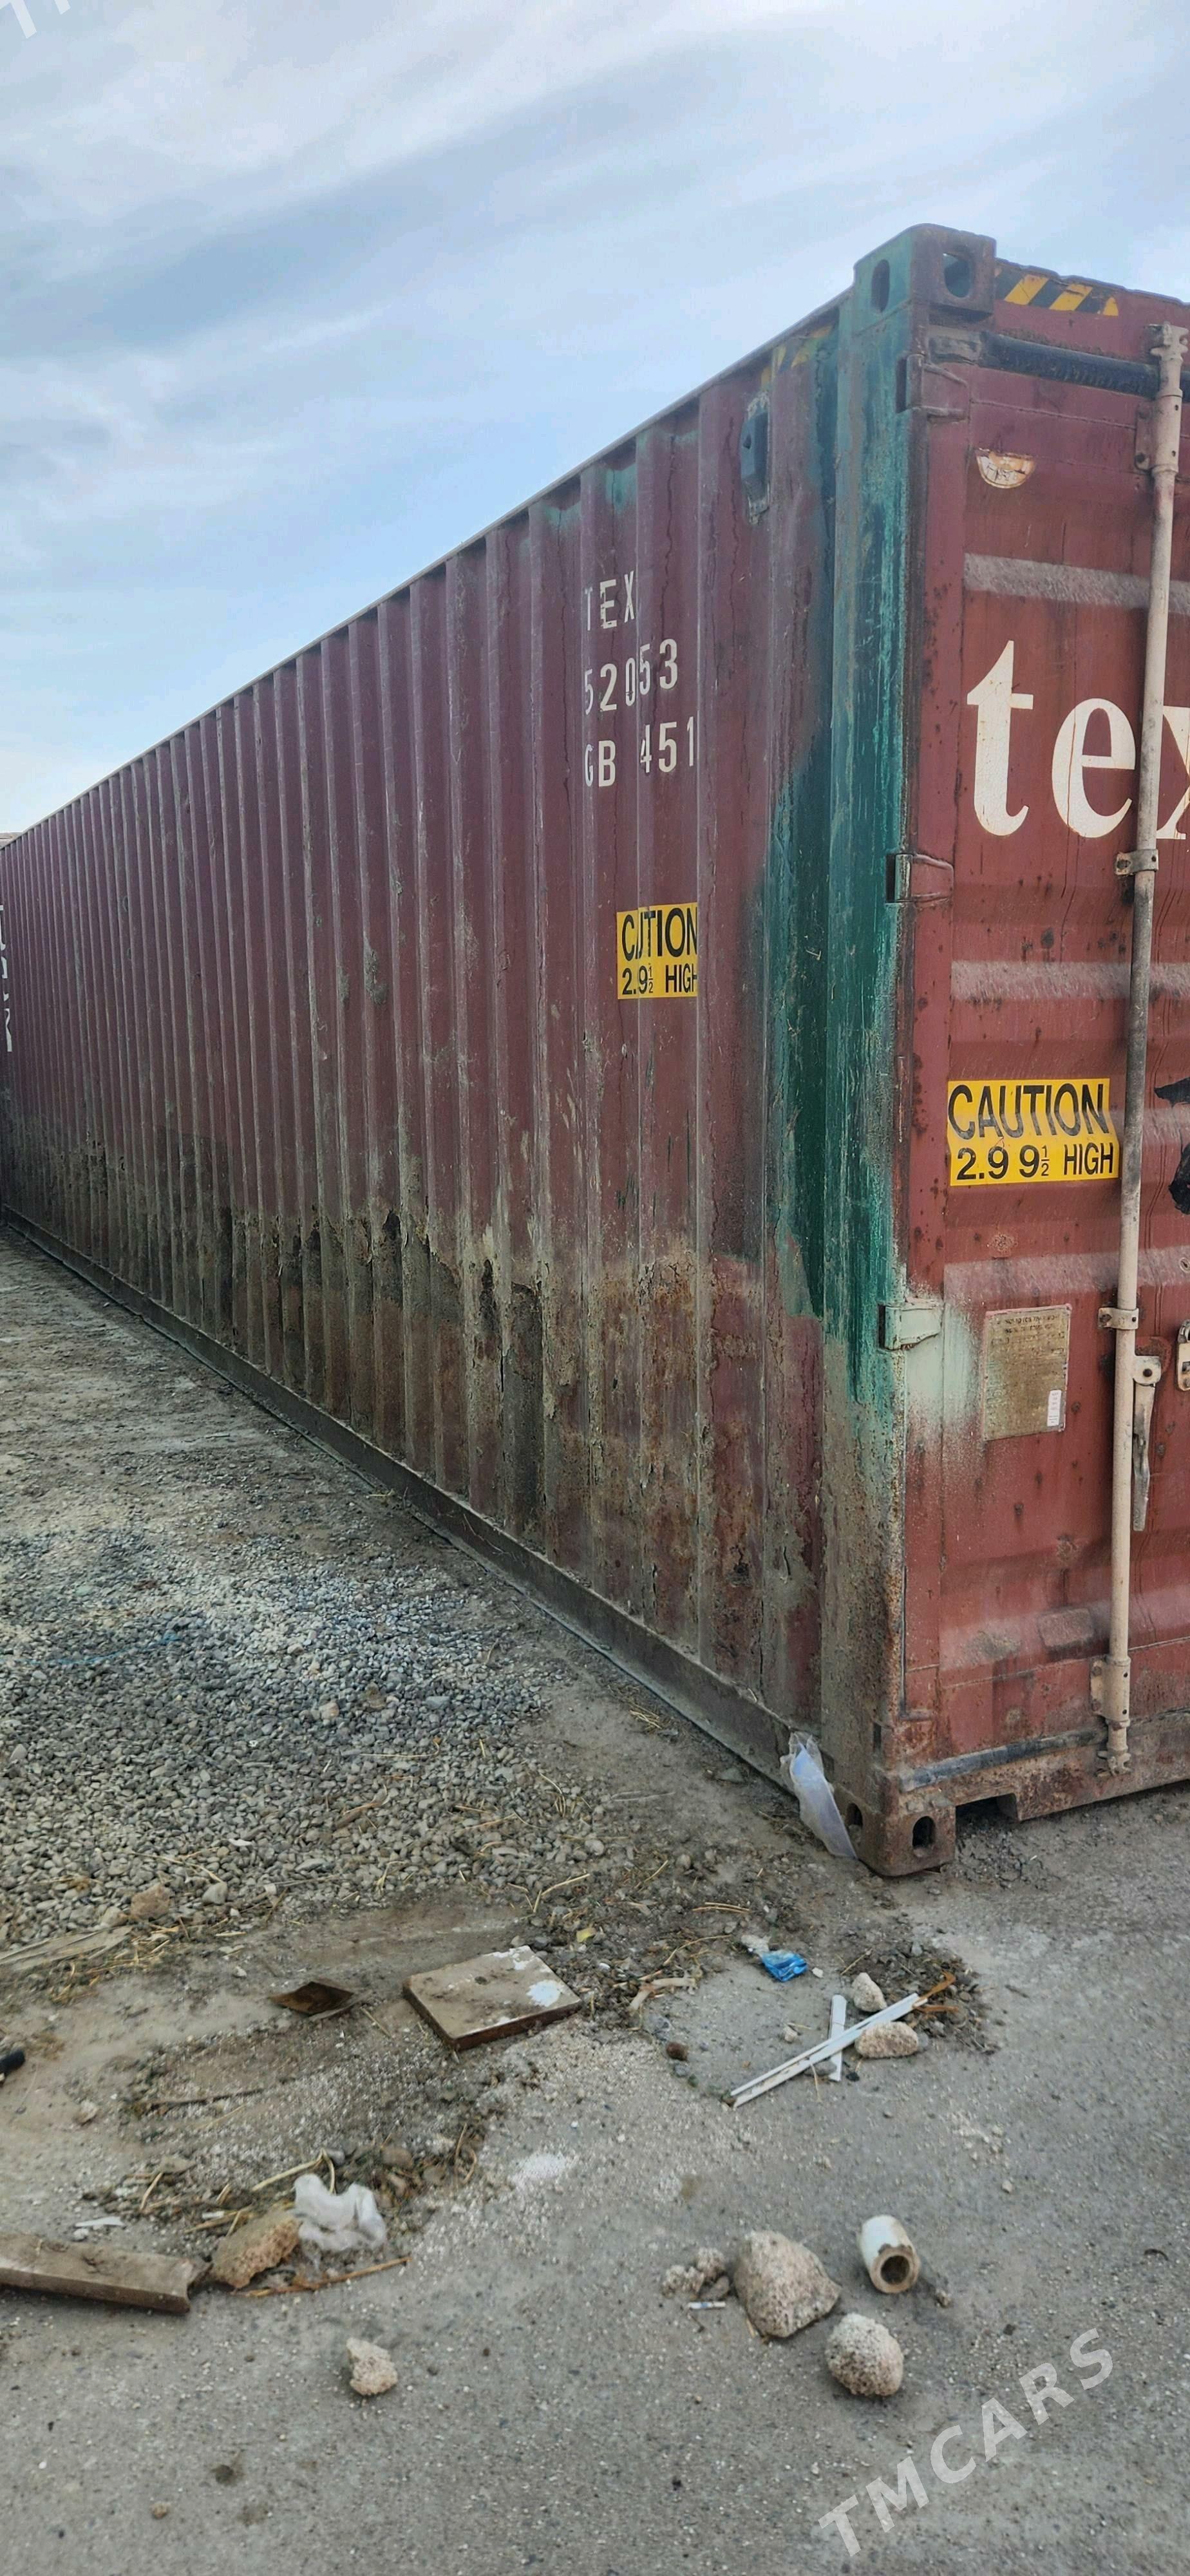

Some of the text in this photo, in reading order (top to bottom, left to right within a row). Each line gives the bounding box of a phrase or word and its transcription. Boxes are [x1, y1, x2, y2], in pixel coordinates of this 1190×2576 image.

[585, 571, 634, 630] TEX
[585, 639, 678, 715] 52053
[585, 716, 694, 787] GB 451
[665, 963, 697, 992] HIGH
[948, 1083, 1110, 1139] CAUTION
[1064, 1142, 1113, 1175] HIGH
